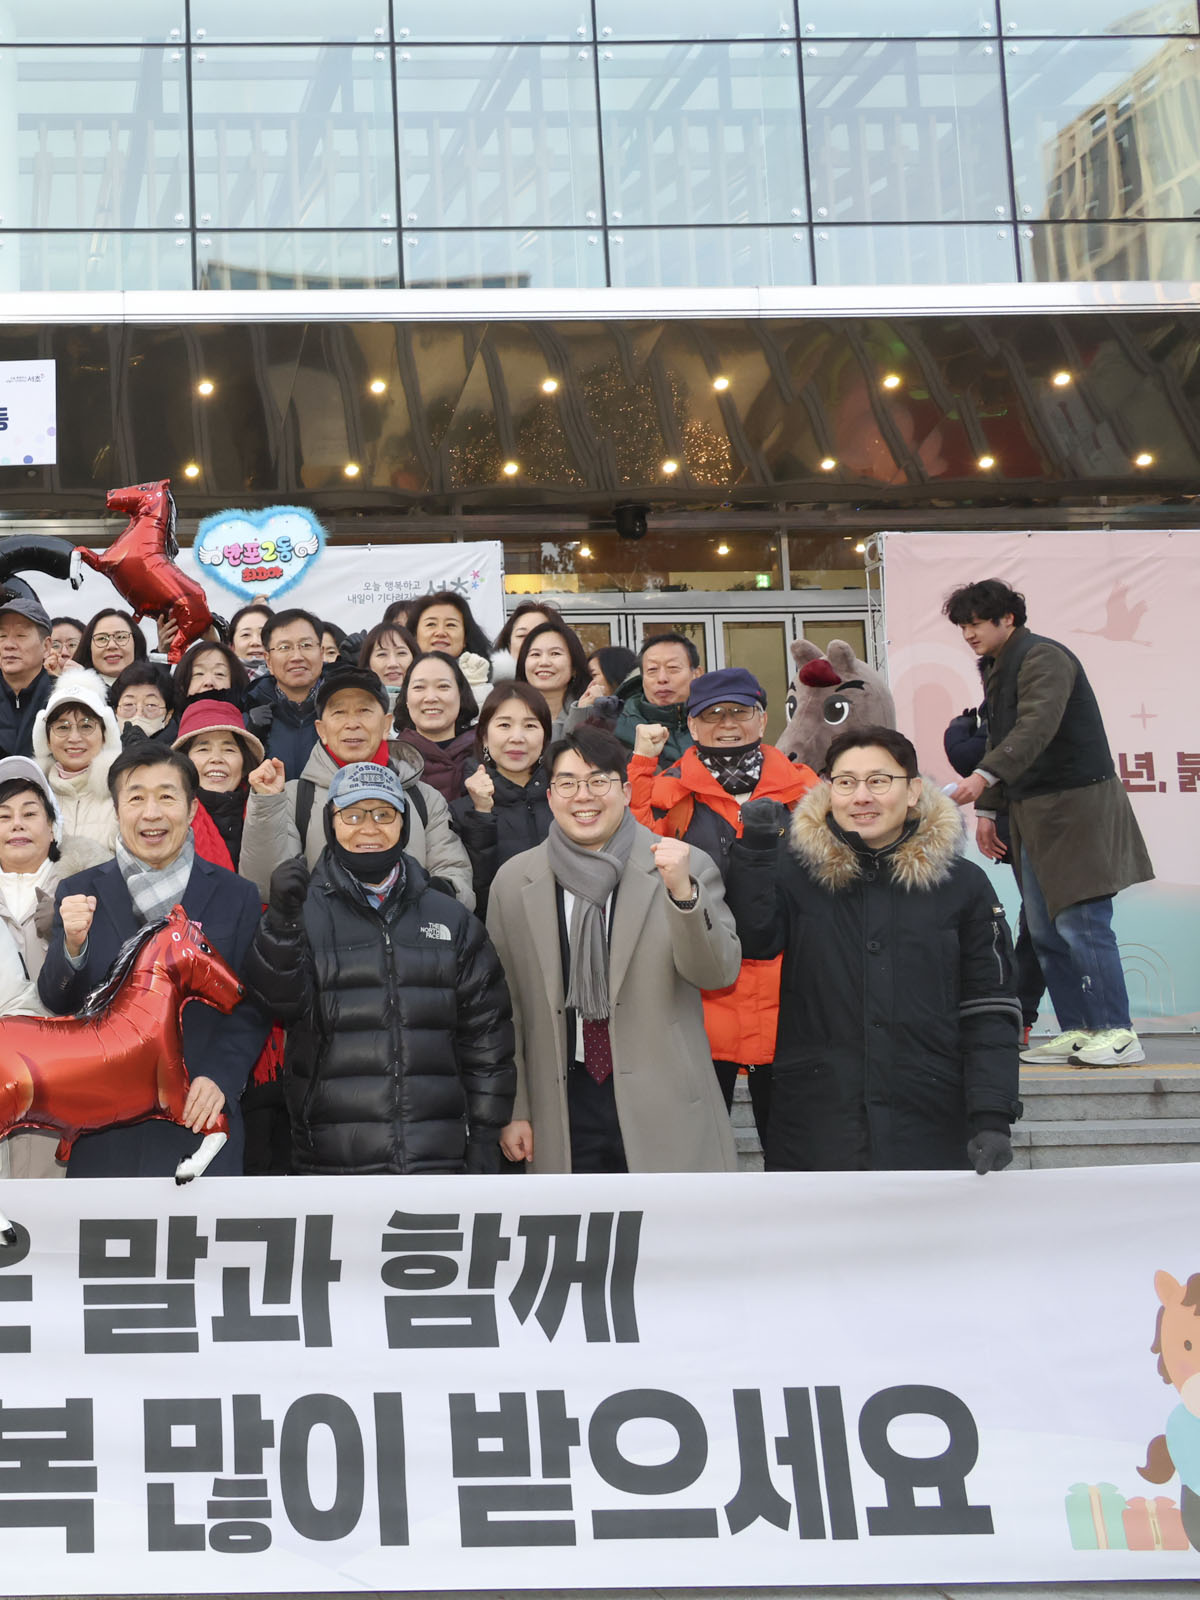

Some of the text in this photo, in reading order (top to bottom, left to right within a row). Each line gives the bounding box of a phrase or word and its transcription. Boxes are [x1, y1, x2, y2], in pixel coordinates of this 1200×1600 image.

[223, 535, 294, 567] 반포2동
[347, 594, 374, 604] 내일이
[363, 580, 381, 592] 오늘
[384, 580, 422, 592] 행복하고
[78, 1214, 342, 1354] 말과
[380, 1209, 644, 1350] 함께
[143, 1392, 409, 1553] 많이
[450, 1385, 995, 1547] 받으세요
